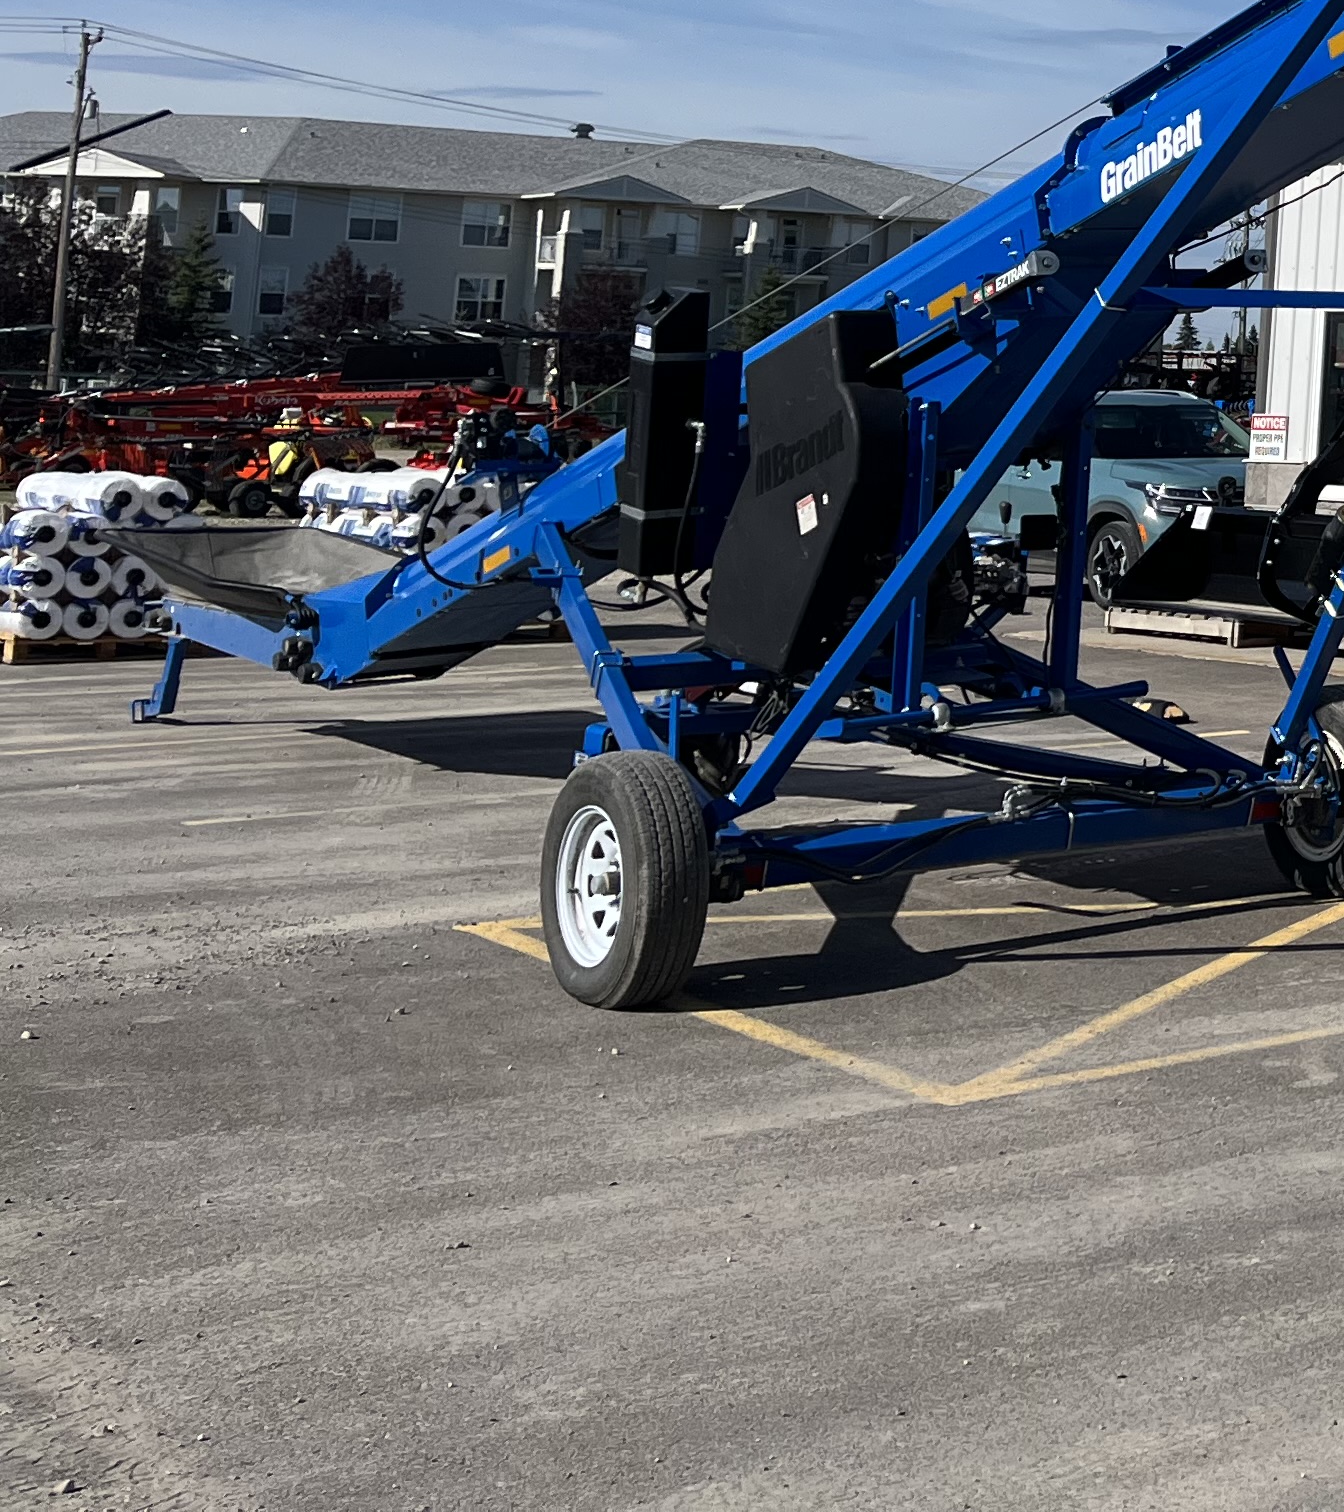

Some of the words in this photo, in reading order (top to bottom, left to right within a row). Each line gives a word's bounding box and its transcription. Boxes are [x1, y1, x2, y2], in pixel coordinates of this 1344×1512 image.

[1100, 108, 1202, 204] GrainBelt
[995, 260, 1030, 293] EZTRAK
[254, 394, 298, 406] Kubota
[1252, 416, 1286, 430] NOTICE
[770, 409, 845, 489] Brandt
